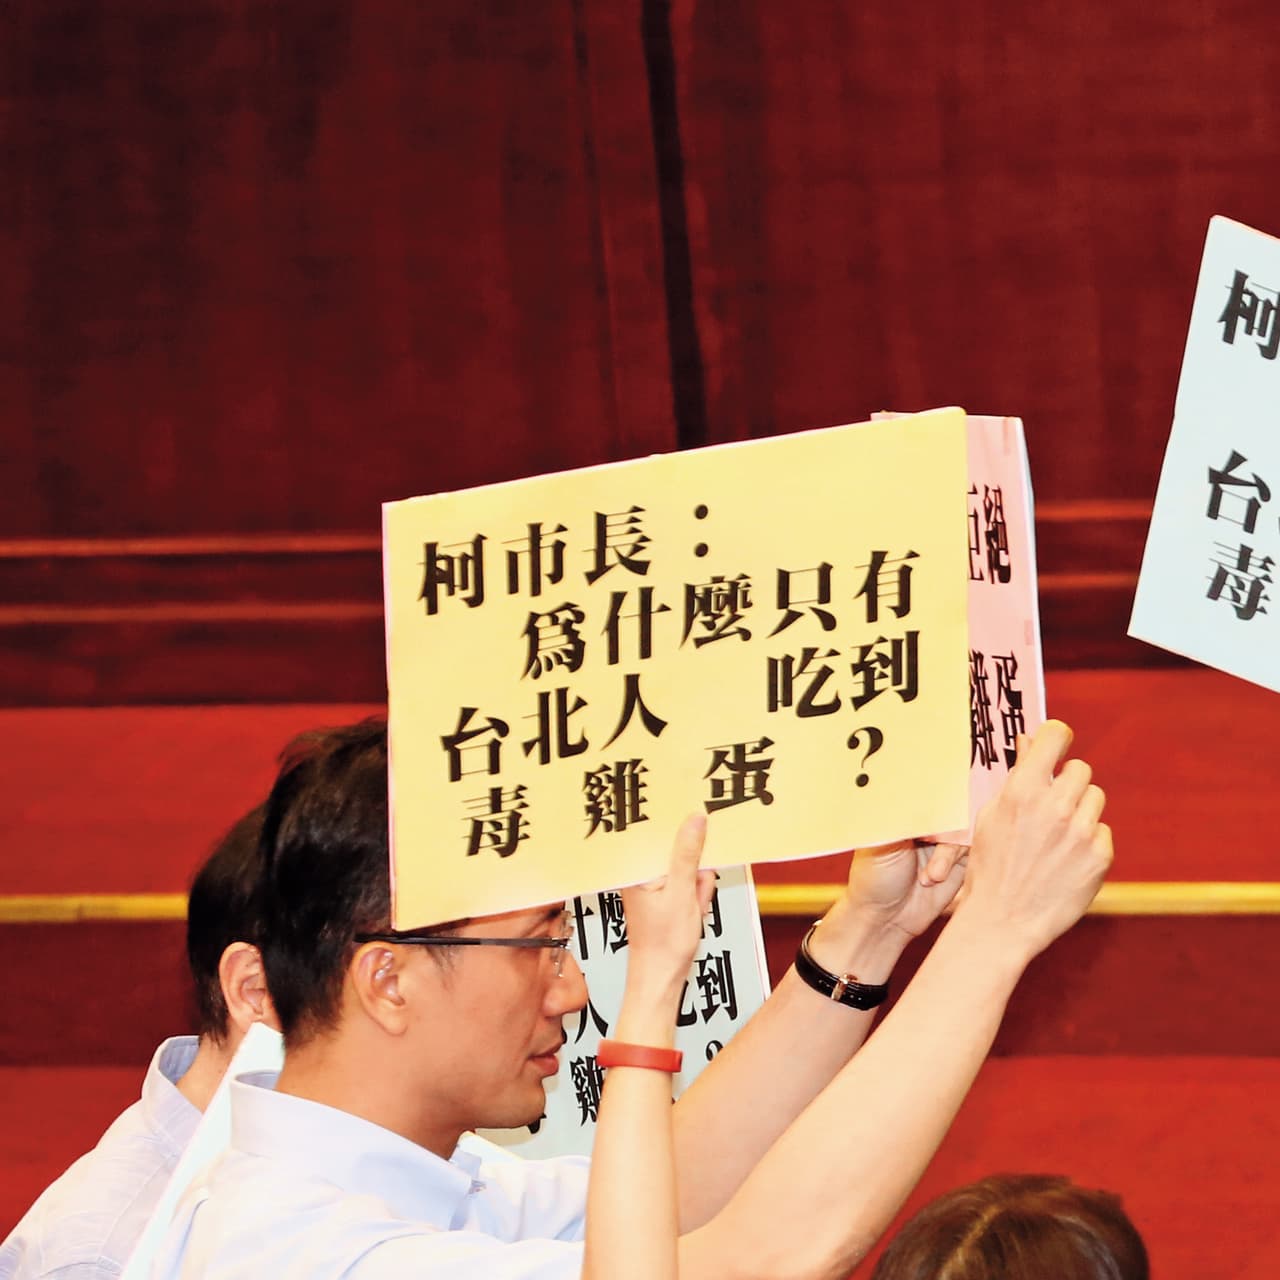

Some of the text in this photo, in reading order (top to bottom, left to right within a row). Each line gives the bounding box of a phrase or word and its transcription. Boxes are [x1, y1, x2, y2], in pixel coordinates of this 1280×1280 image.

[416, 503, 712, 617] 柯市長：
[439, 629, 921, 783] 台北人 吃到
